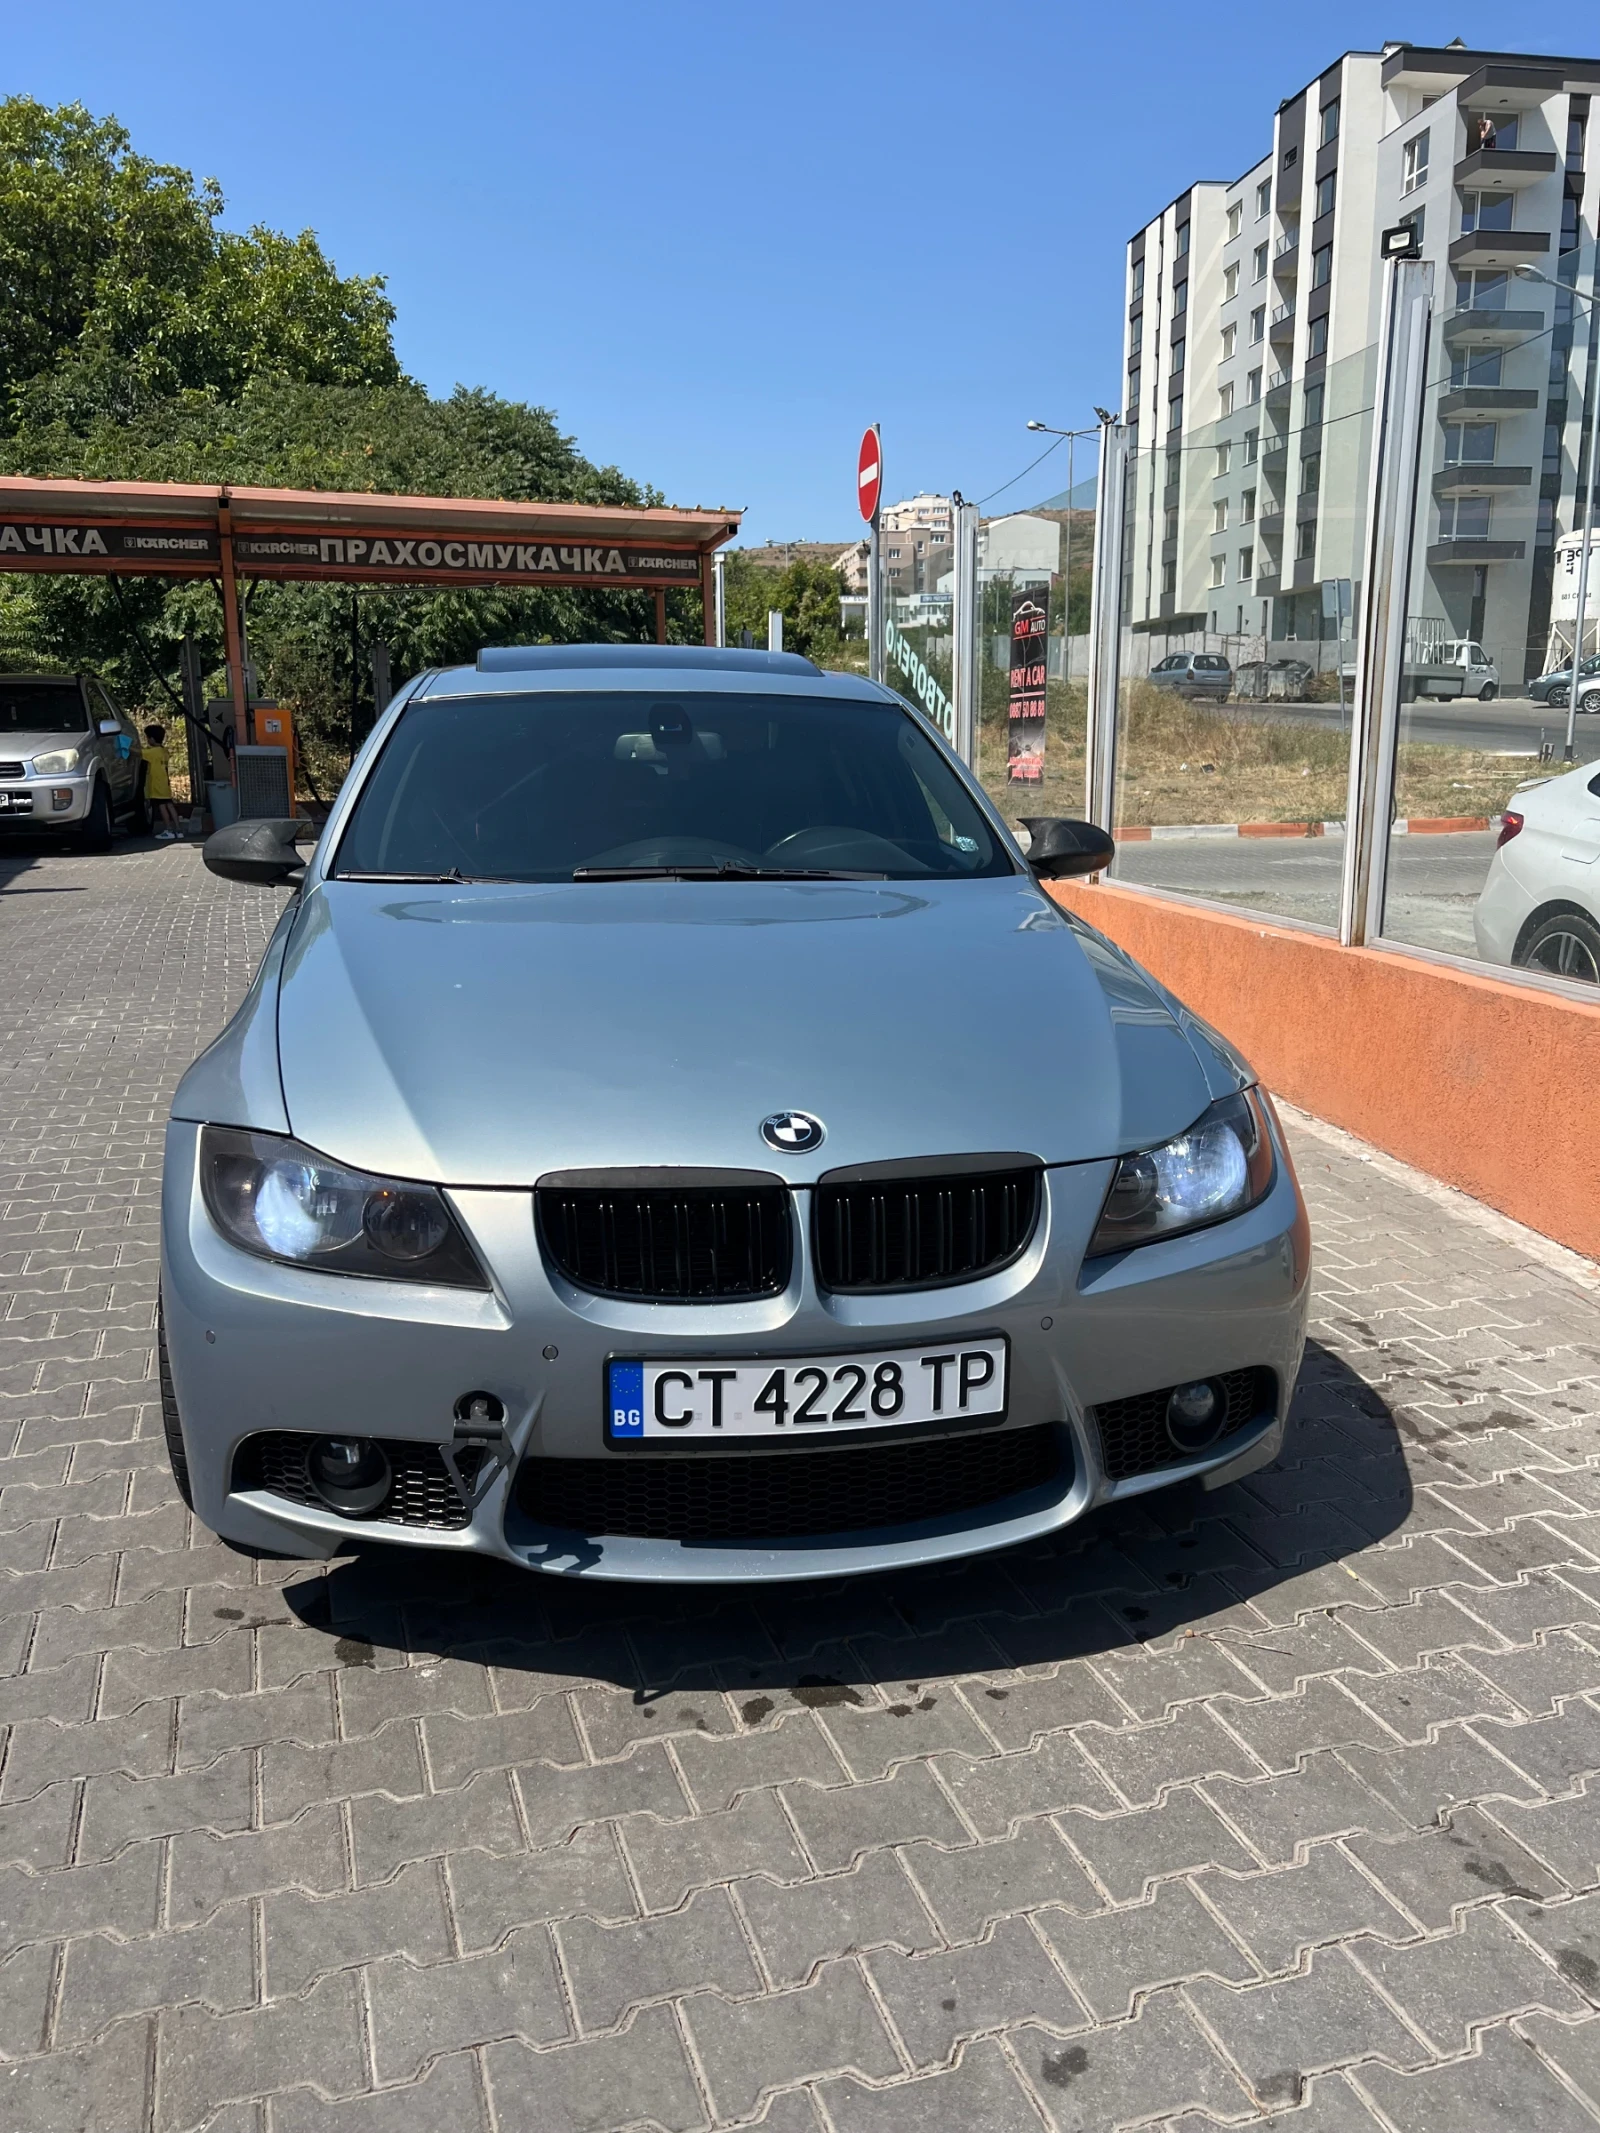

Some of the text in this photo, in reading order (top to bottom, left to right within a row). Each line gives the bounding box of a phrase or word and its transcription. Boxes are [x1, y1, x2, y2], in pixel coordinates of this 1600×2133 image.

[319, 538, 626, 573] ПРАХОСМУКАЧКА
[1014, 619, 1046, 635] GM AUTO
[1010, 665, 1045, 689] RENT A CAR
[653, 1350, 995, 1427] CT 4228 TP
[614, 1408, 640, 1427] BG
